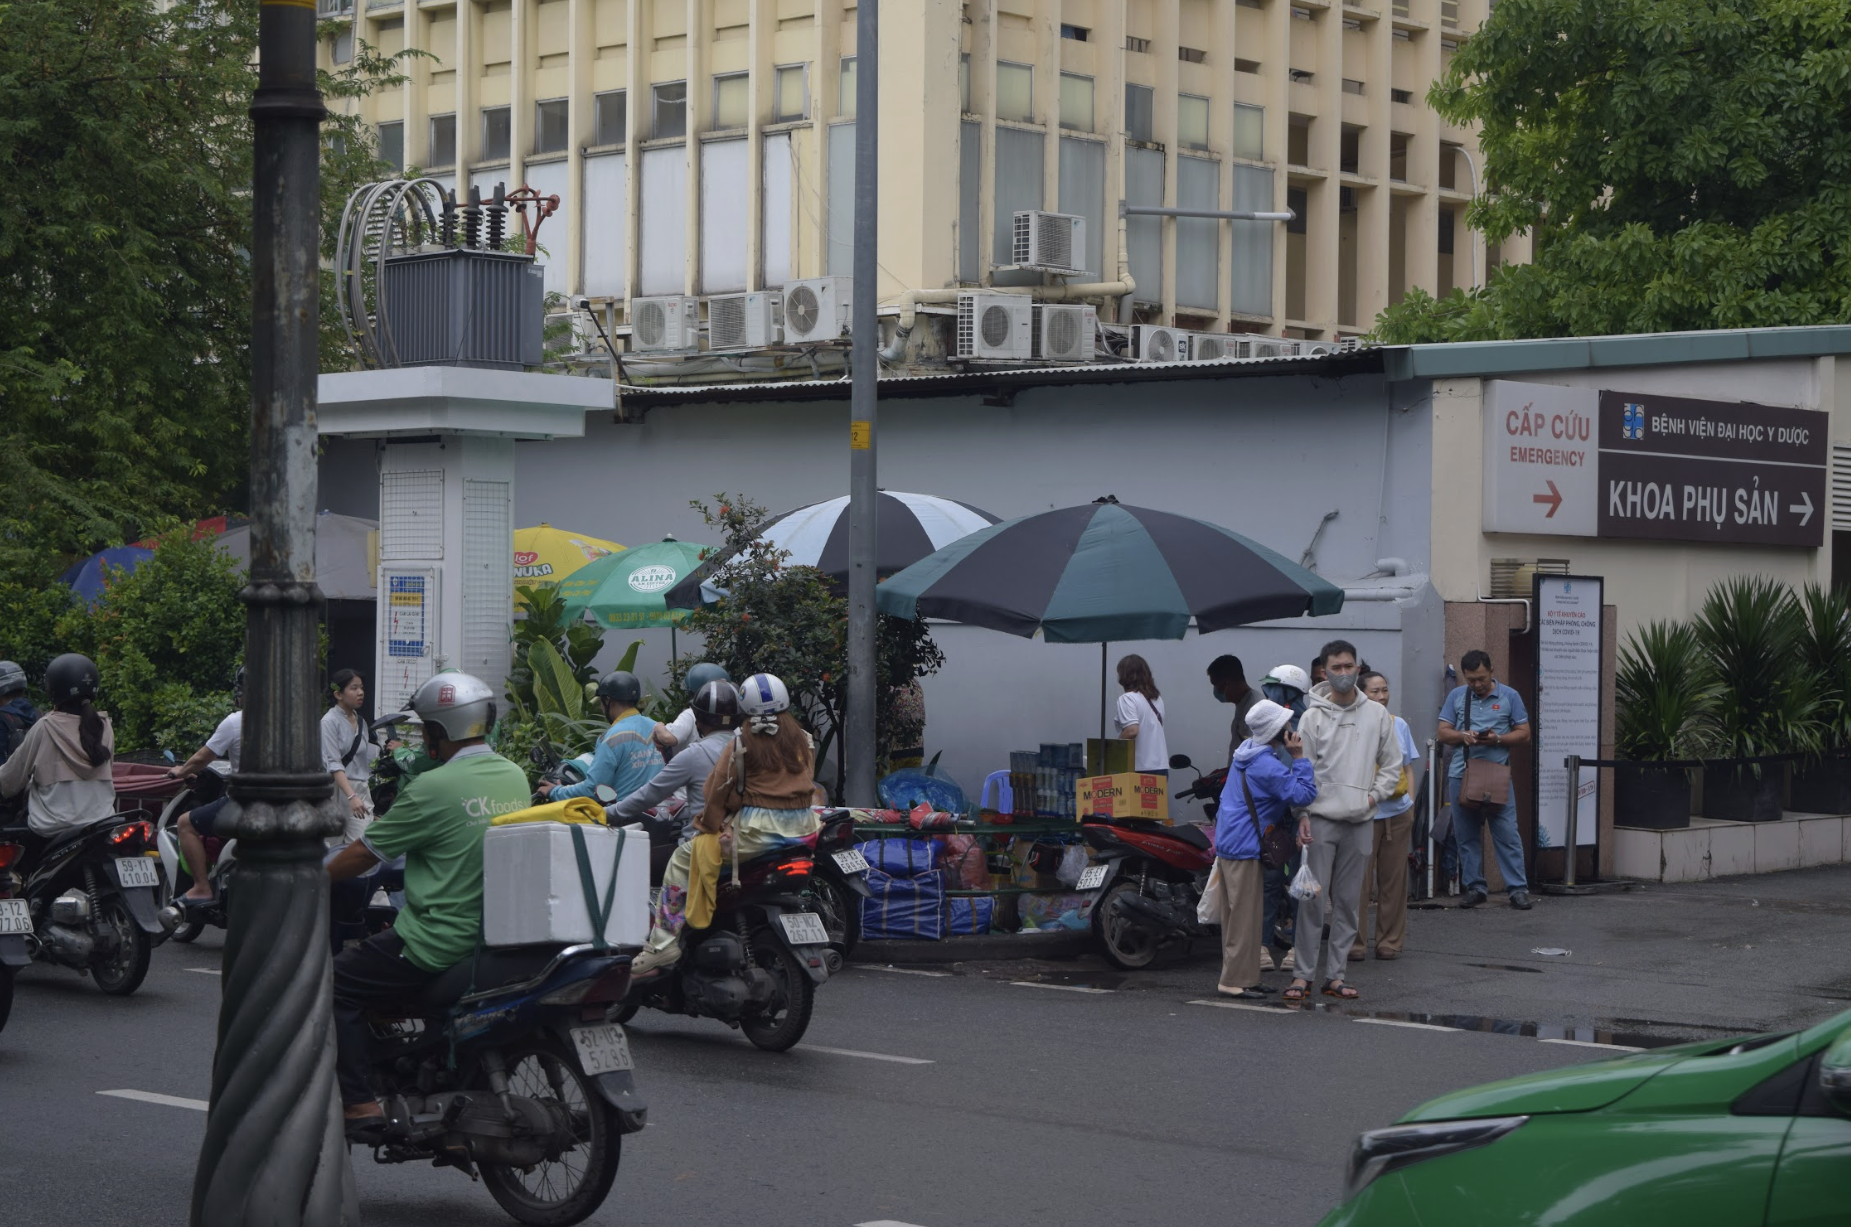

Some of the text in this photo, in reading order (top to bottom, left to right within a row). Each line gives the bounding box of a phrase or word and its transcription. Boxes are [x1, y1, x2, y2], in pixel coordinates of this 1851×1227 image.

[1506, 402, 1589, 441] CẤP CỨU
[1652, 413, 1809, 446] BỆNH VIỆN ĐẠI HỌC Y DƯỢC
[1510, 446, 1585, 467] EMERGENCY
[1609, 475, 1778, 530] KHOA PHỤ SẢN
[631, 574, 673, 582] ALINA
[1083, 787, 1122, 800] MODERN
[1134, 785, 1164, 796] MODERN
[122, 860, 149, 872] 59-Y1
[123, 872, 156, 885] 410.04
[786, 916, 817, 928] 50-N2
[790, 928, 825, 942] 267.11
[580, 1027, 621, 1048] 52-U3
[589, 1048, 629, 1069] 5286
